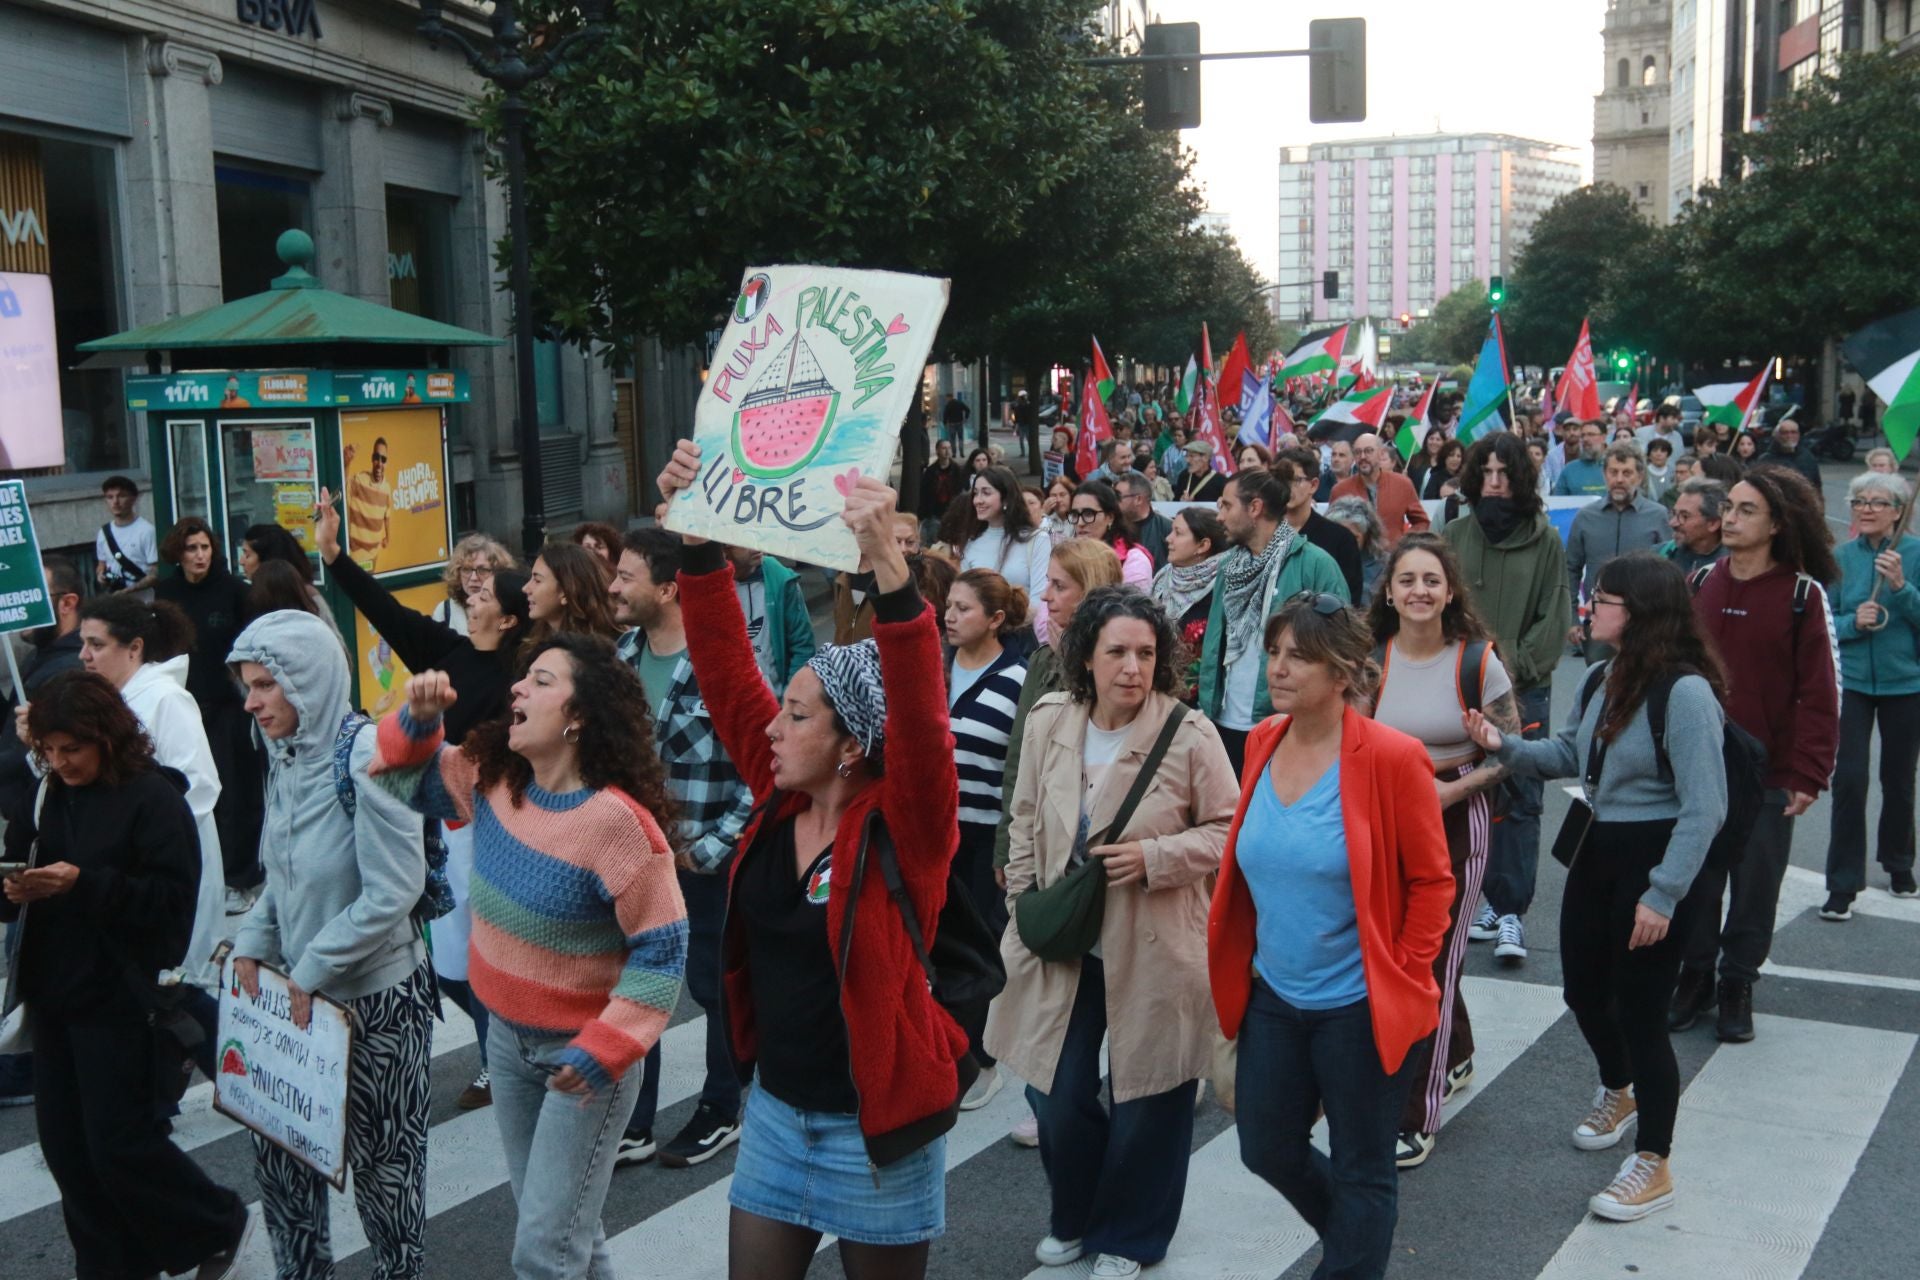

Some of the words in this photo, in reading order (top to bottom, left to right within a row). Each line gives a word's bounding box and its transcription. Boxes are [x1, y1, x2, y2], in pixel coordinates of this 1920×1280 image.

[713, 313, 784, 404] PUXA
[796, 286, 895, 410] PALESTINA
[164, 385, 209, 403] 11/11
[362, 381, 395, 399] 11/11
[398, 462, 431, 490] AHORA
[393, 479, 439, 511] SIEMPRE
[275, 1031, 310, 1068] MUNDO
[251, 1061, 312, 1122] PALESTINA
